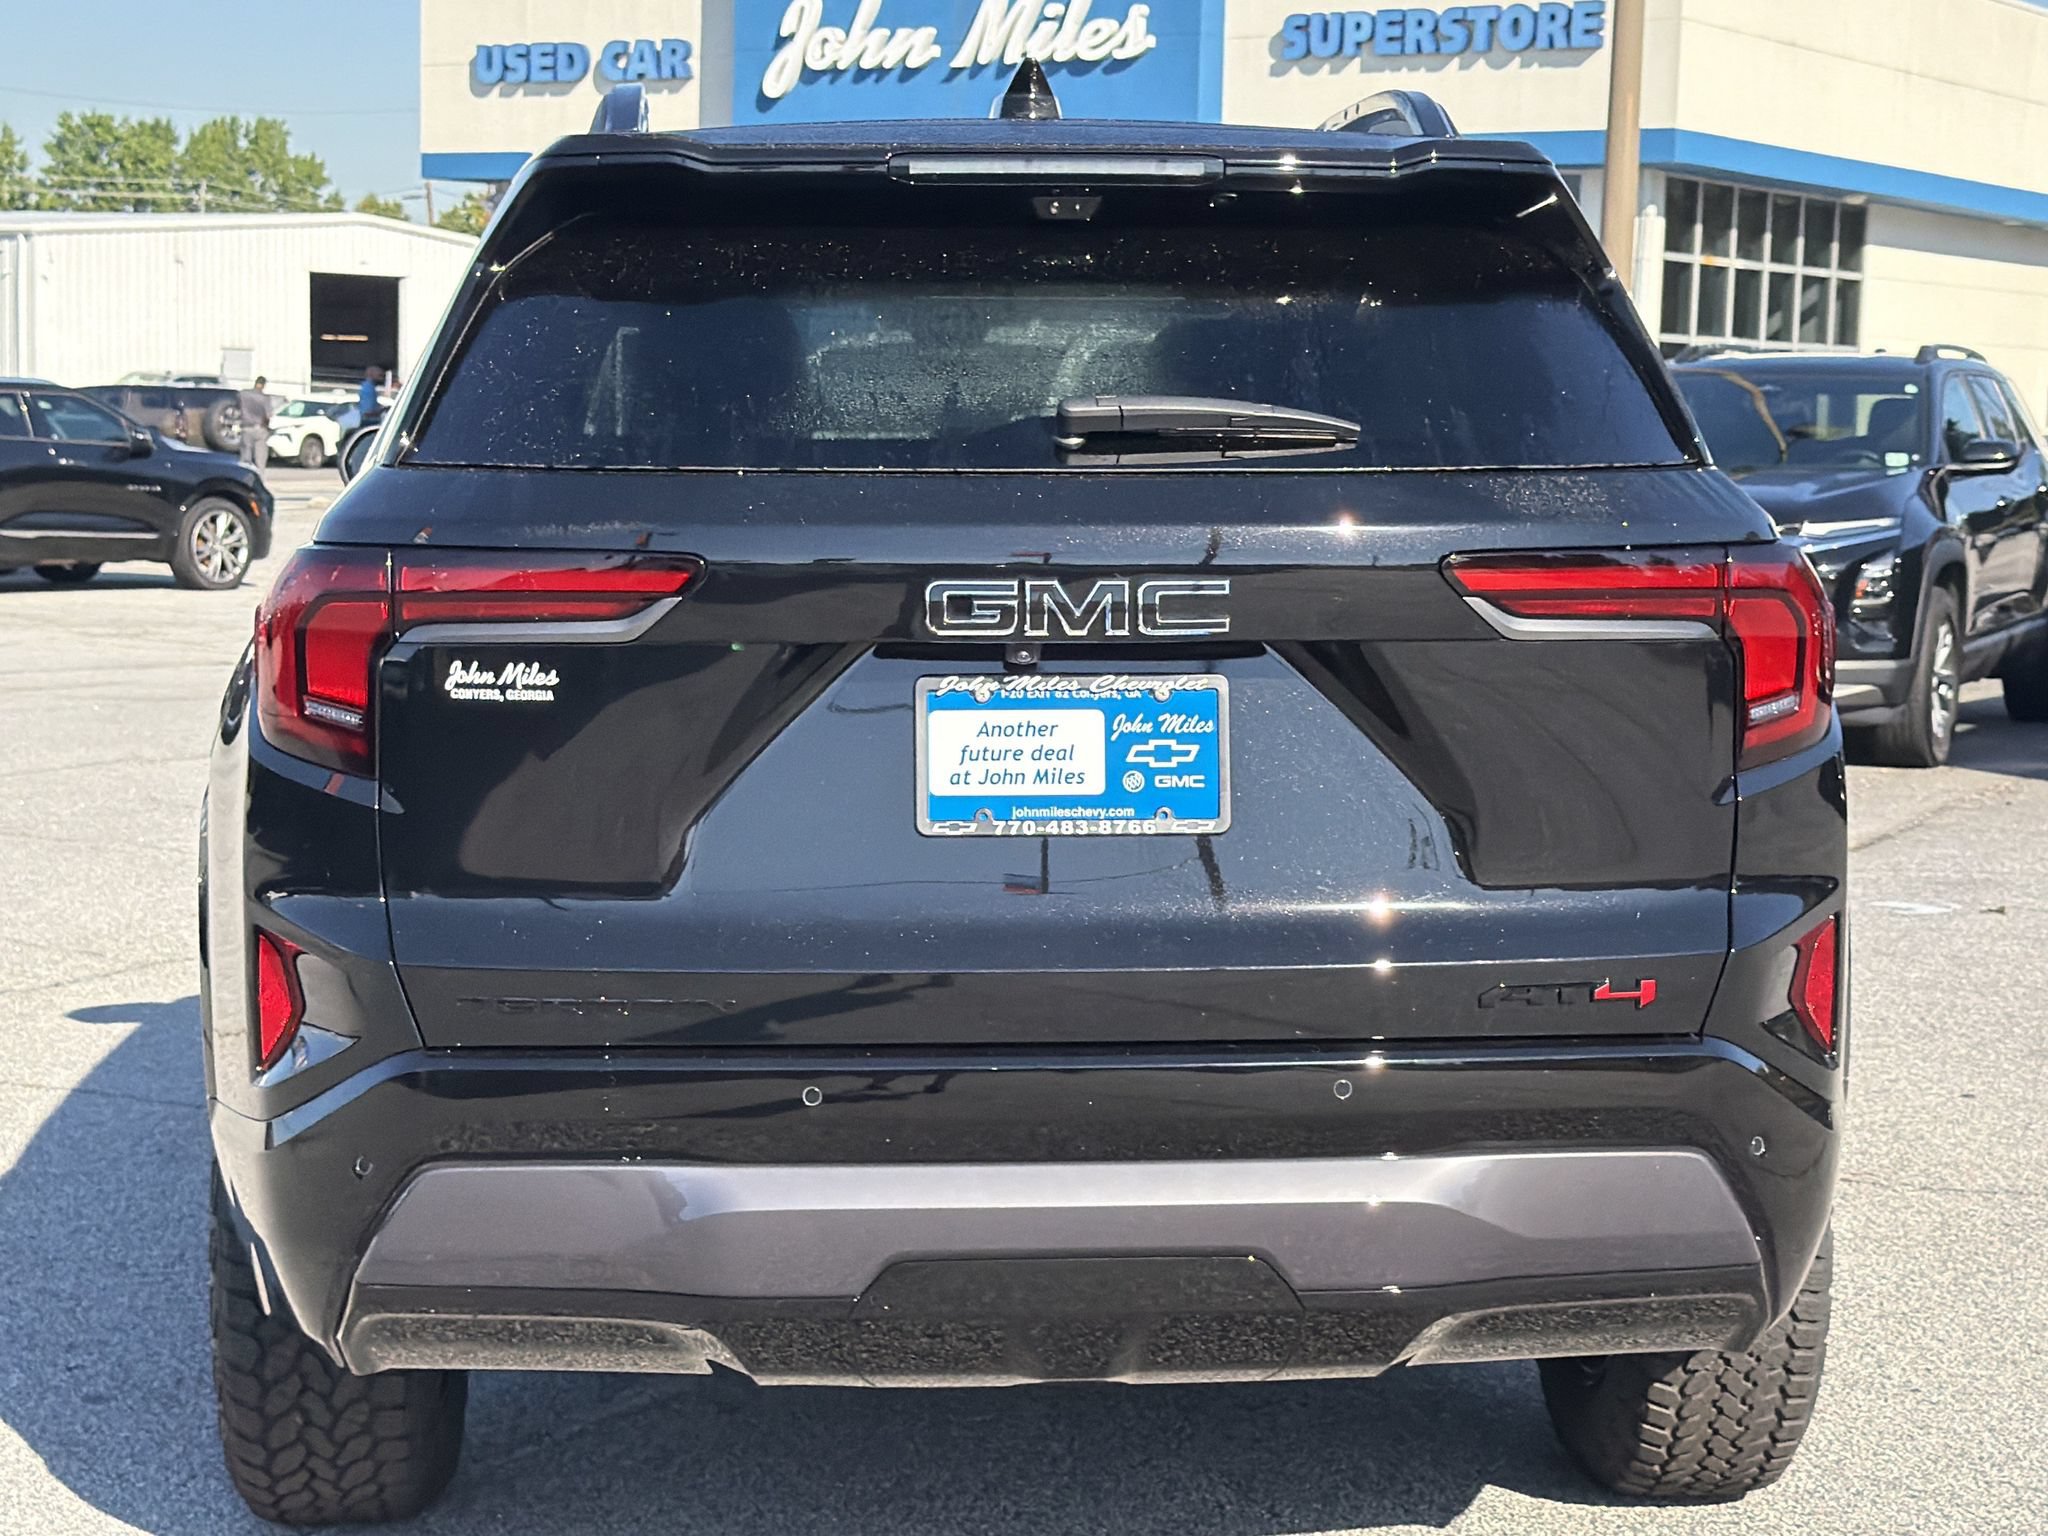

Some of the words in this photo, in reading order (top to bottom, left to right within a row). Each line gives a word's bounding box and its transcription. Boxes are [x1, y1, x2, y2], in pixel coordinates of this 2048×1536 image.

[1280, 0, 1605, 61] SUPERSTORE
[762, 0, 941, 99] John
[949, 0, 1157, 65] Miles
[474, 42, 590, 84] USED
[600, 38, 693, 81] CAR
[925, 579, 1230, 636] GMC
[444, 660, 496, 690] John
[497, 661, 560, 689] Miles
[936, 676, 1001, 697] John
[1003, 675, 1081, 691] Miles
[1089, 674, 1209, 693] Chevrolet
[505, 688, 554, 701] GEORGIA
[976, 720, 1059, 738] Another
[1110, 713, 1154, 741] John
[1157, 712, 1215, 734] Miles
[959, 744, 1024, 766] future
[1030, 744, 1075, 761] deal
[949, 769, 971, 786] at
[978, 768, 1026, 785] John
[1032, 767, 1086, 785] Miles
[1154, 774, 1206, 788] GMC
[1011, 806, 1135, 820] johnmileschevy.com
[992, 819, 1158, 836] 770-483-8766
